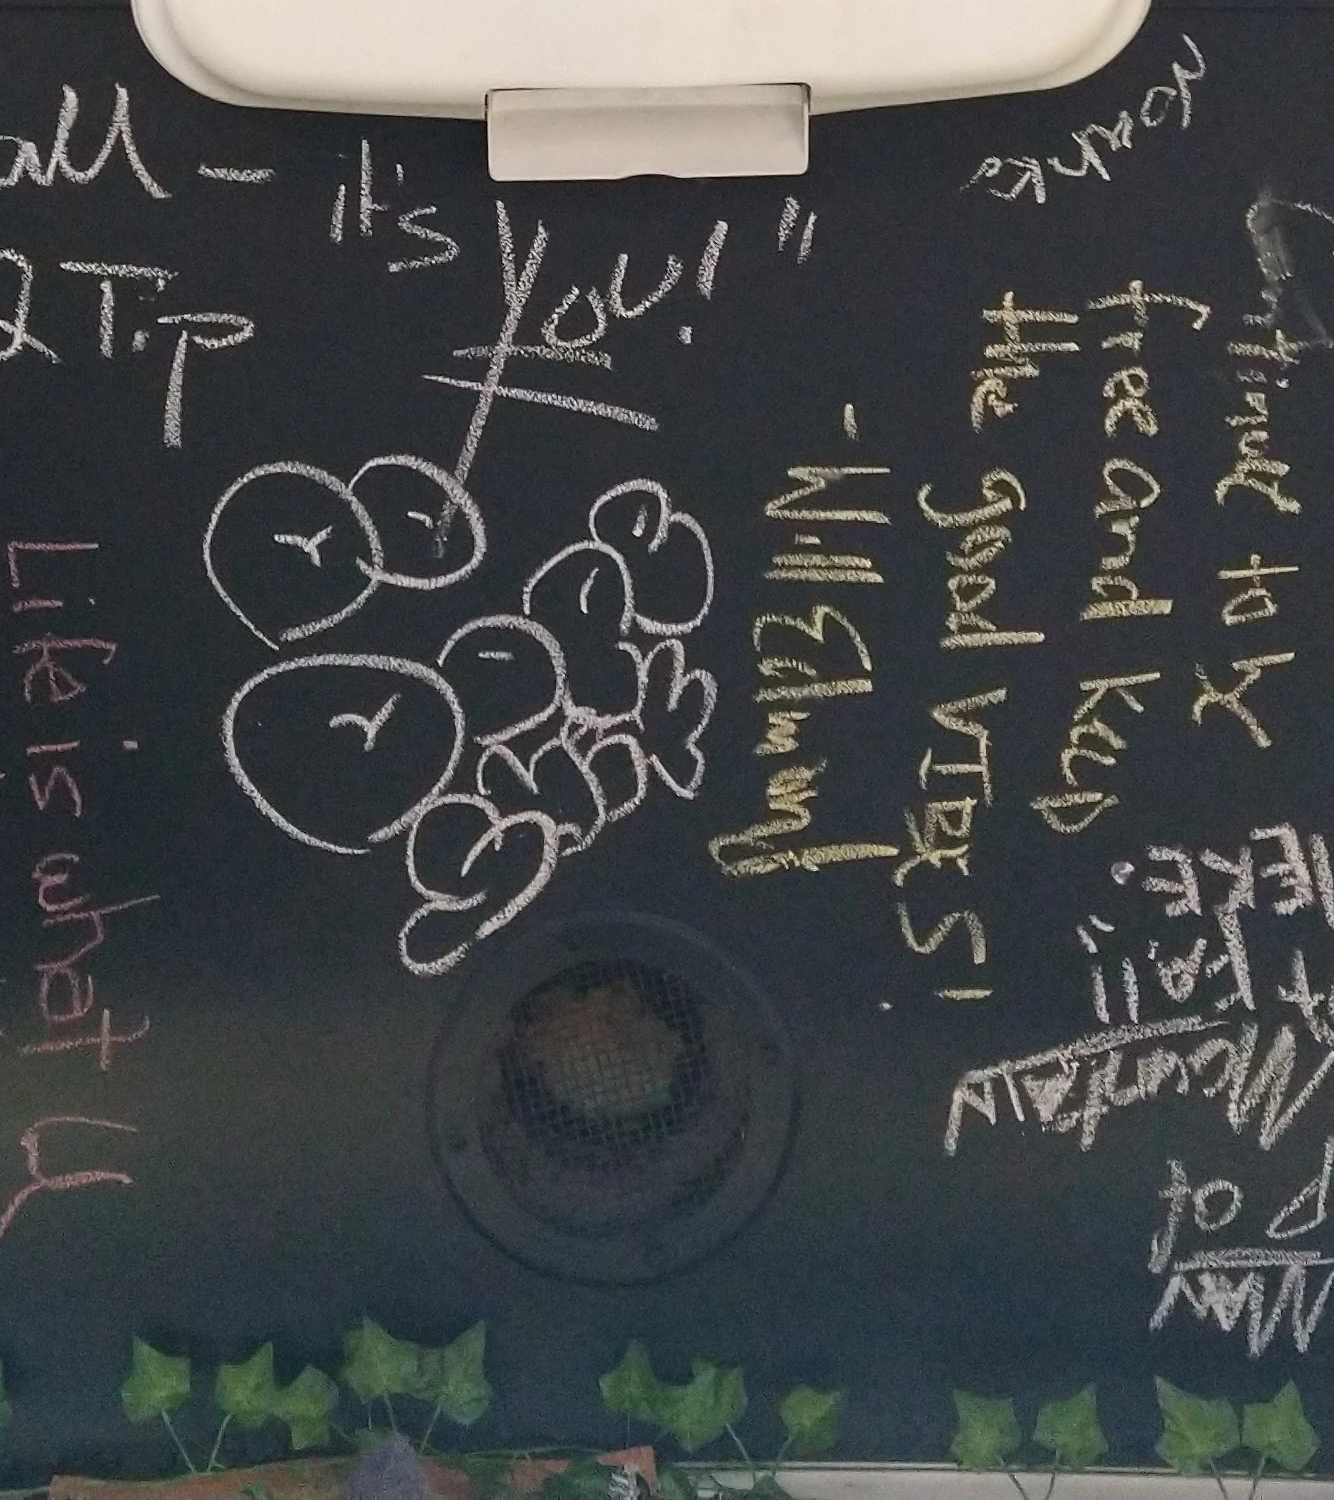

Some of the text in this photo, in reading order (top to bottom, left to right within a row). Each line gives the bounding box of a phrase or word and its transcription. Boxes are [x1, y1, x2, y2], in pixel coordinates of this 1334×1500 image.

[1078, 457, 1174, 620] and
[1215, 554, 1300, 625] to
[6, 539, 117, 702] Life
[25, 738, 140, 816] is
[19, 853, 160, 1070] what
